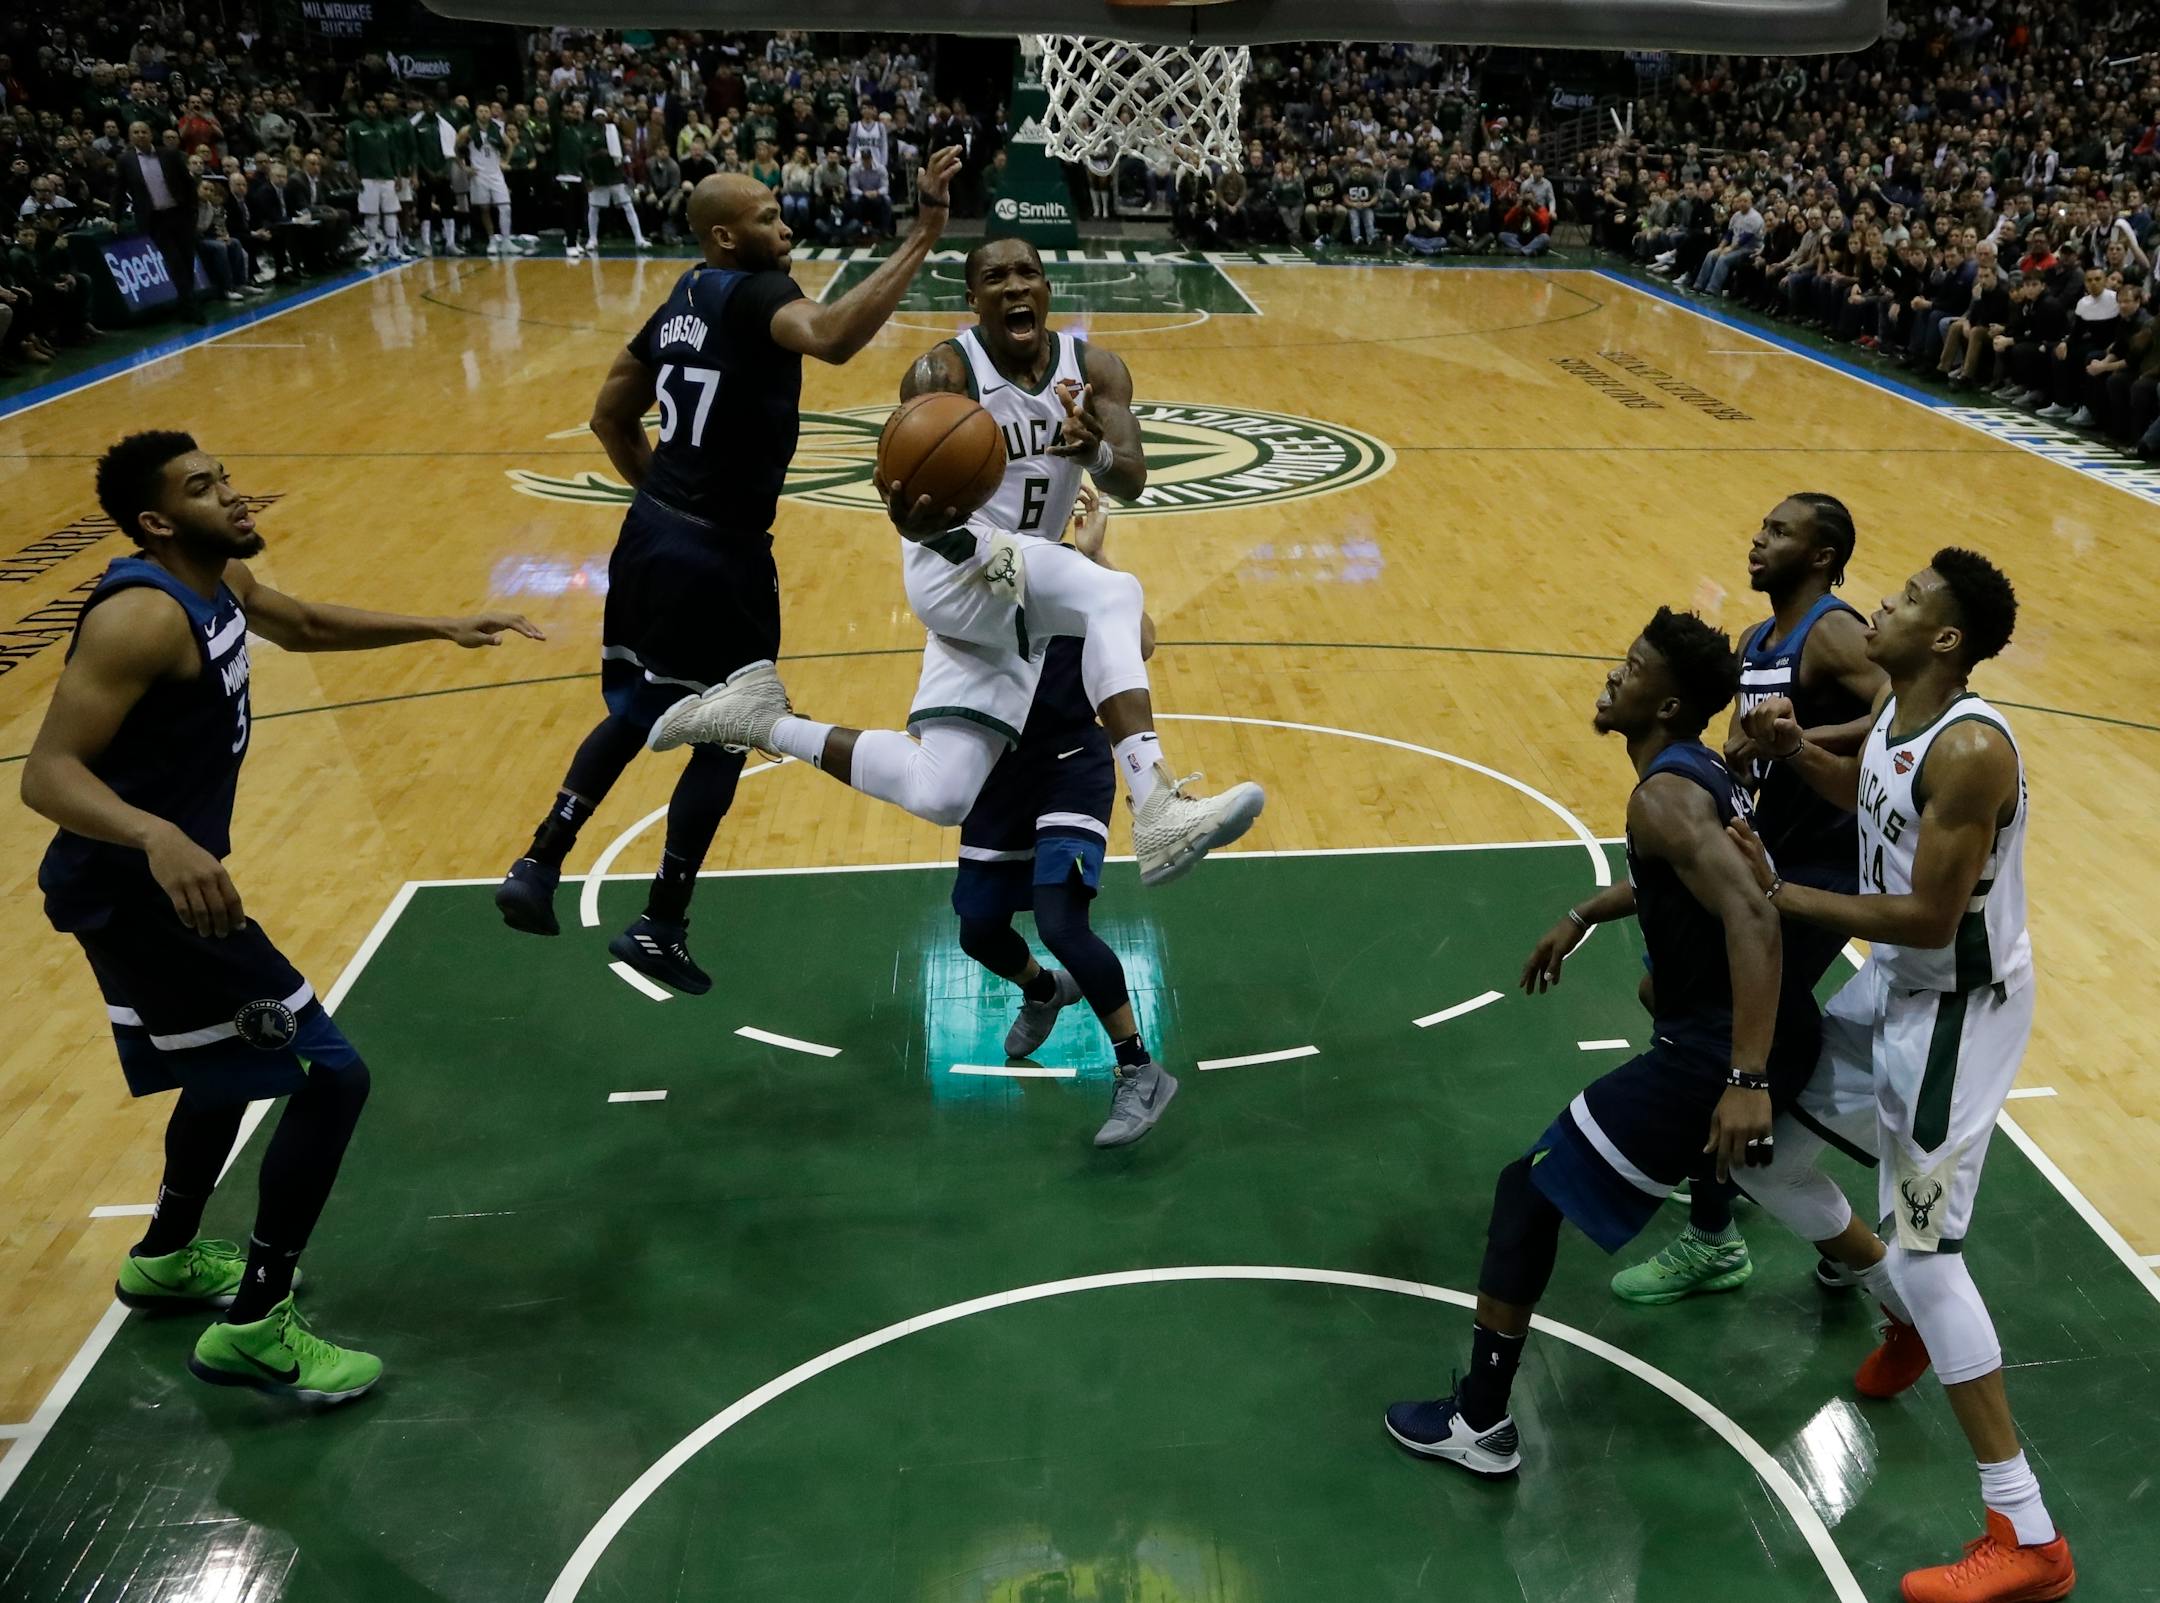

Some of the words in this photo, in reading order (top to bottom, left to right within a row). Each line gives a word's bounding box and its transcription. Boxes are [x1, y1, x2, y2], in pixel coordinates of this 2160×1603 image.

[301, 1, 374, 21] MILWAUKEE
[1019, 202, 1066, 217] Smith
[659, 314, 708, 353] GIBSON
[655, 363, 722, 448] 67
[1130, 405, 1303, 437] BUCK
[1017, 478, 1050, 530] 6
[1859, 767, 1908, 845] UCKS
